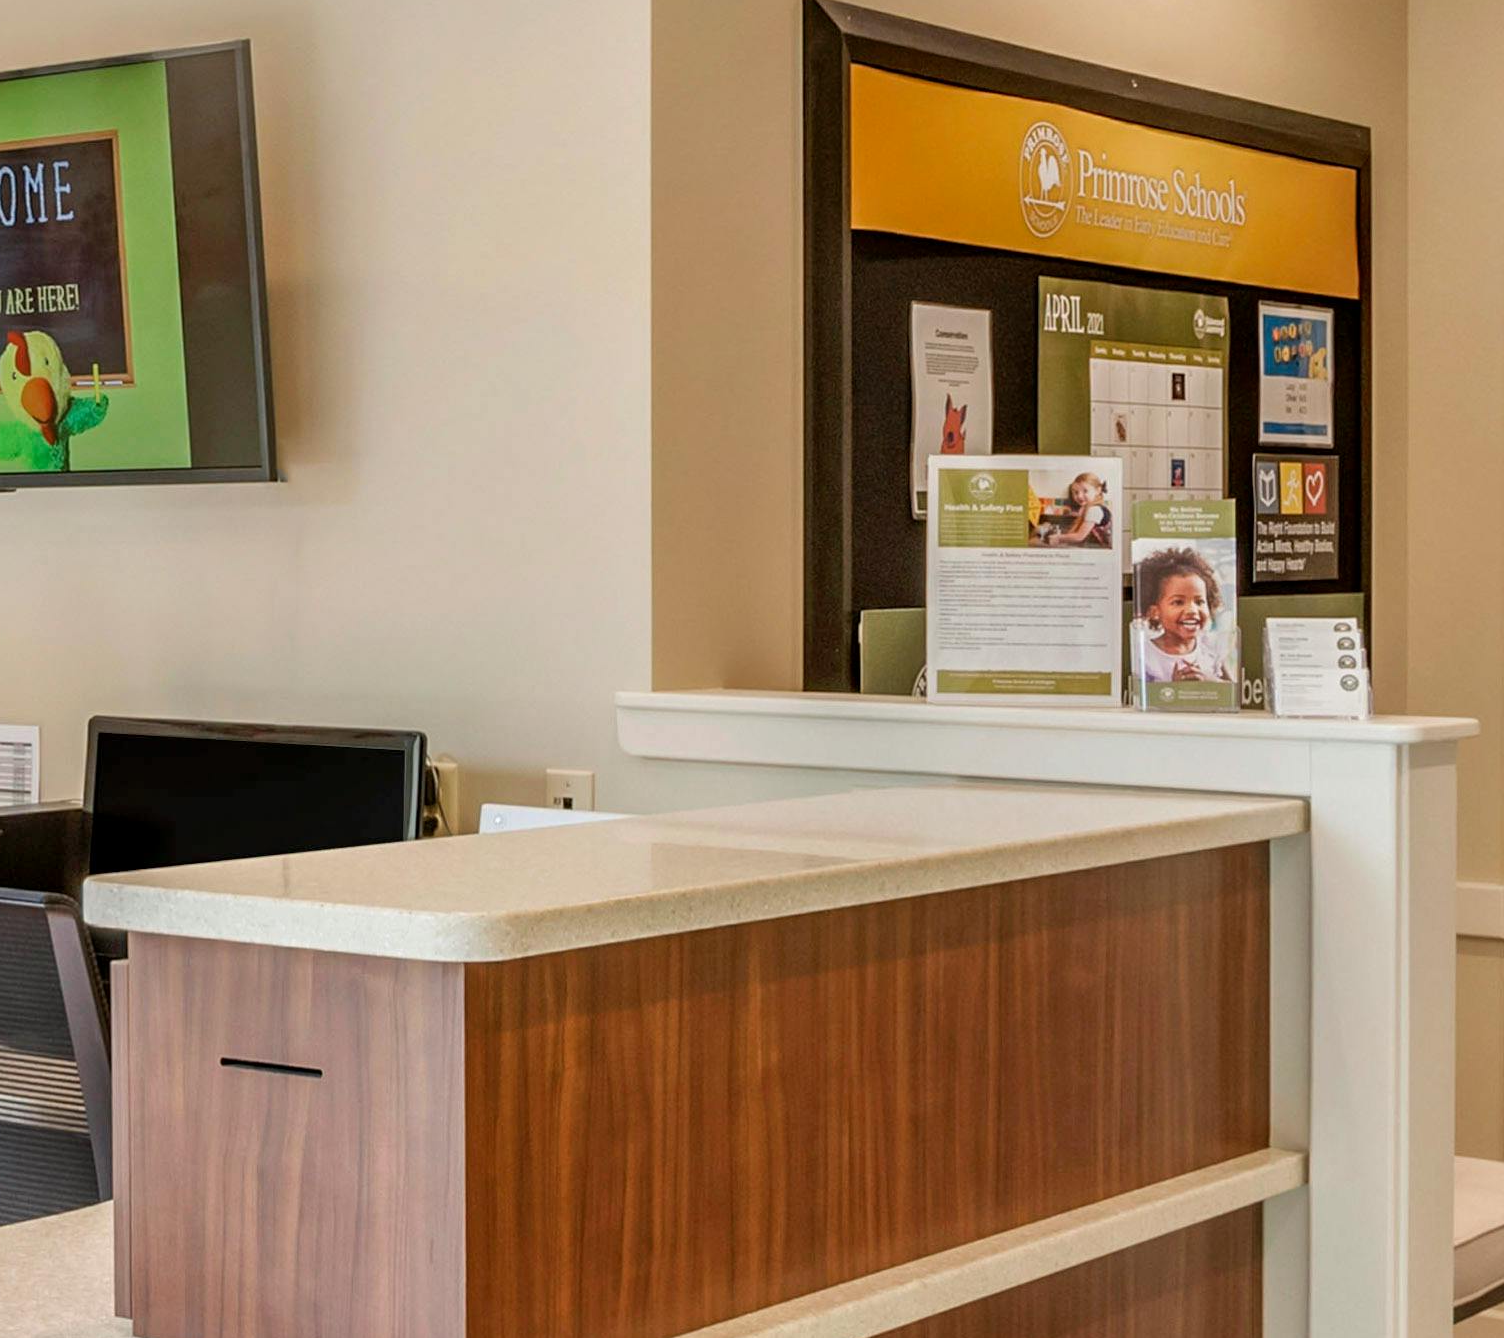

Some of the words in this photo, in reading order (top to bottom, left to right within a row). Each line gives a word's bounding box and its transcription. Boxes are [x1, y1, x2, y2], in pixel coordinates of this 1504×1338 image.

[1077, 149, 1169, 211] Primrose
[1172, 169, 1246, 227] Schools
[1076, 205, 1091, 226] The
[1093, 207, 1121, 231] Leader
[5, 287, 34, 315] ARE
[37, 284, 80, 312] HERE!
[1044, 293, 1085, 334] APRIL
[1087, 312, 1105, 336] 2021
[944, 503, 971, 513] Health
[980, 503, 1005, 514] Safety
